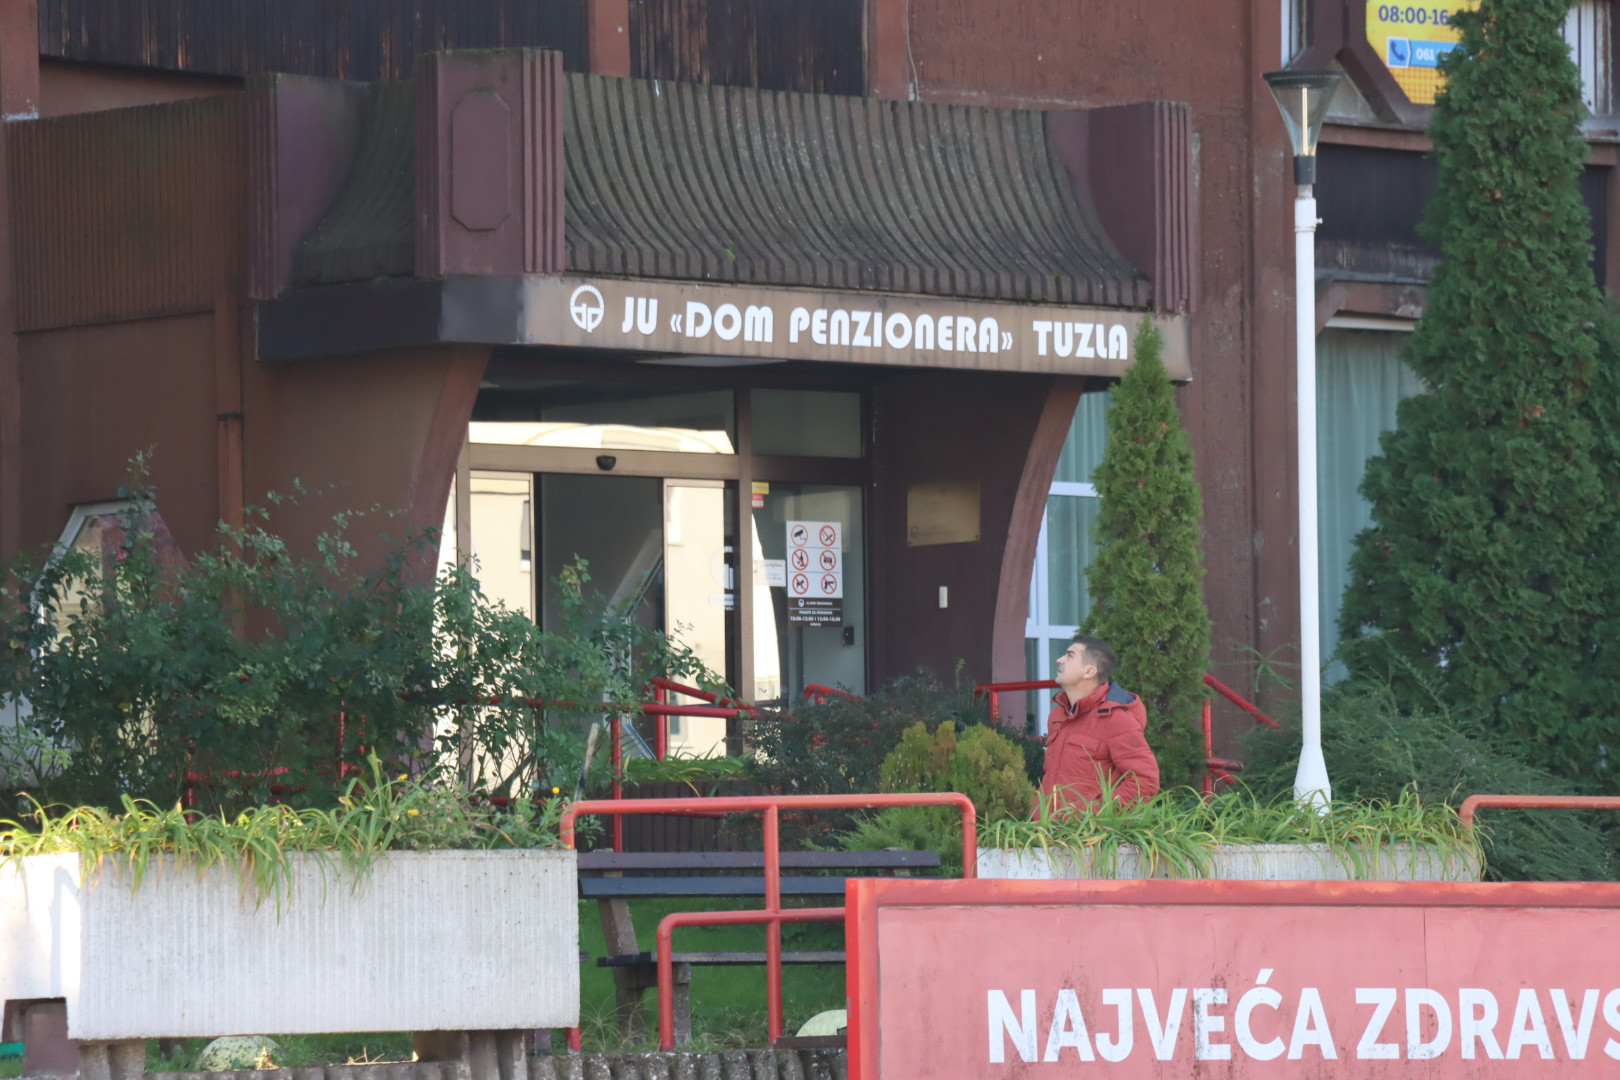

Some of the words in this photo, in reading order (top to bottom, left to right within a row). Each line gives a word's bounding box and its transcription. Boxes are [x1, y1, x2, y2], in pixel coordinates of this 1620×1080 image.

[1415, 48, 1435, 61] 061
[621, 296, 658, 335] JU
[1032, 320, 1128, 360] TUZLA
[987, 968, 1337, 1063] NAJVEĆA
